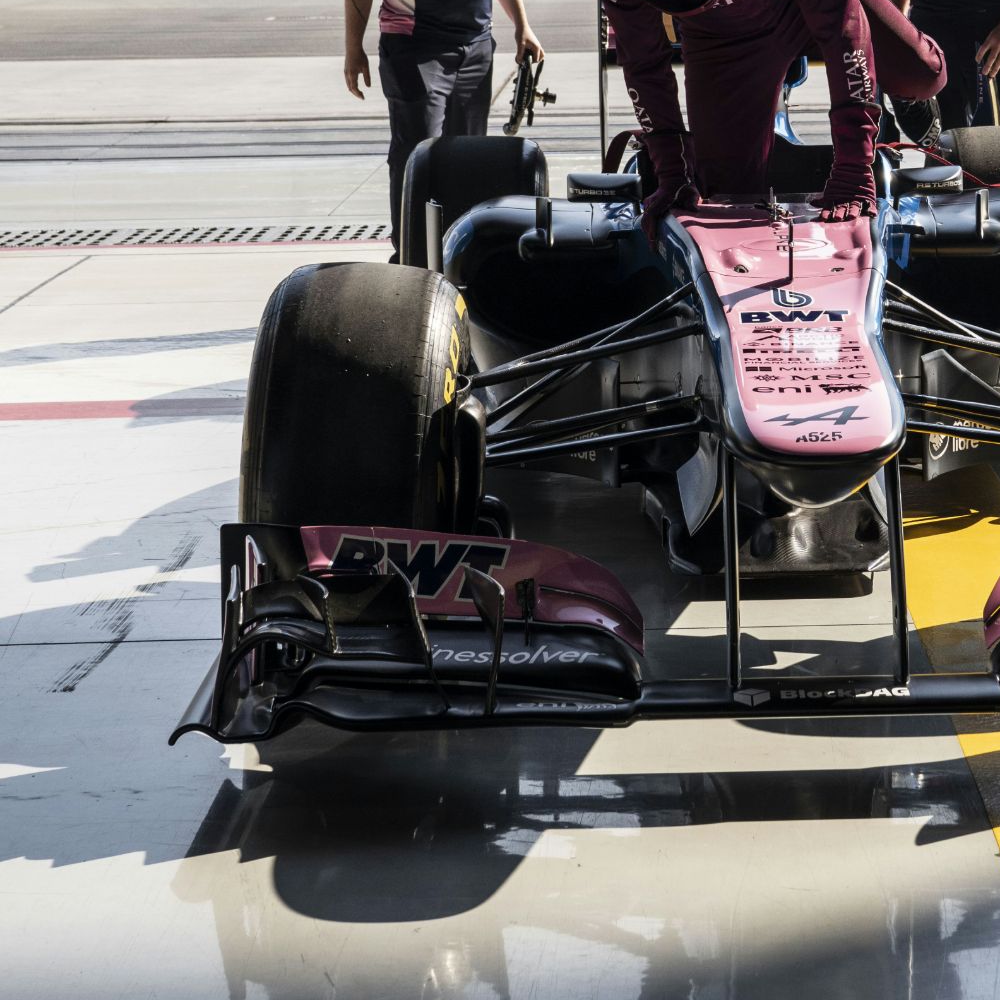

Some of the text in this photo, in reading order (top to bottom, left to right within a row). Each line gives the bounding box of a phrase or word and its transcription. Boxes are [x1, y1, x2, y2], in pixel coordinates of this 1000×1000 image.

[843, 49, 866, 102] ATAR
[740, 310, 849, 324] BWT
[791, 372, 871, 381] MSC
[752, 384, 812, 394] eni
[795, 431, 843, 443] A525
[780, 687, 911, 699] BlockDAG
